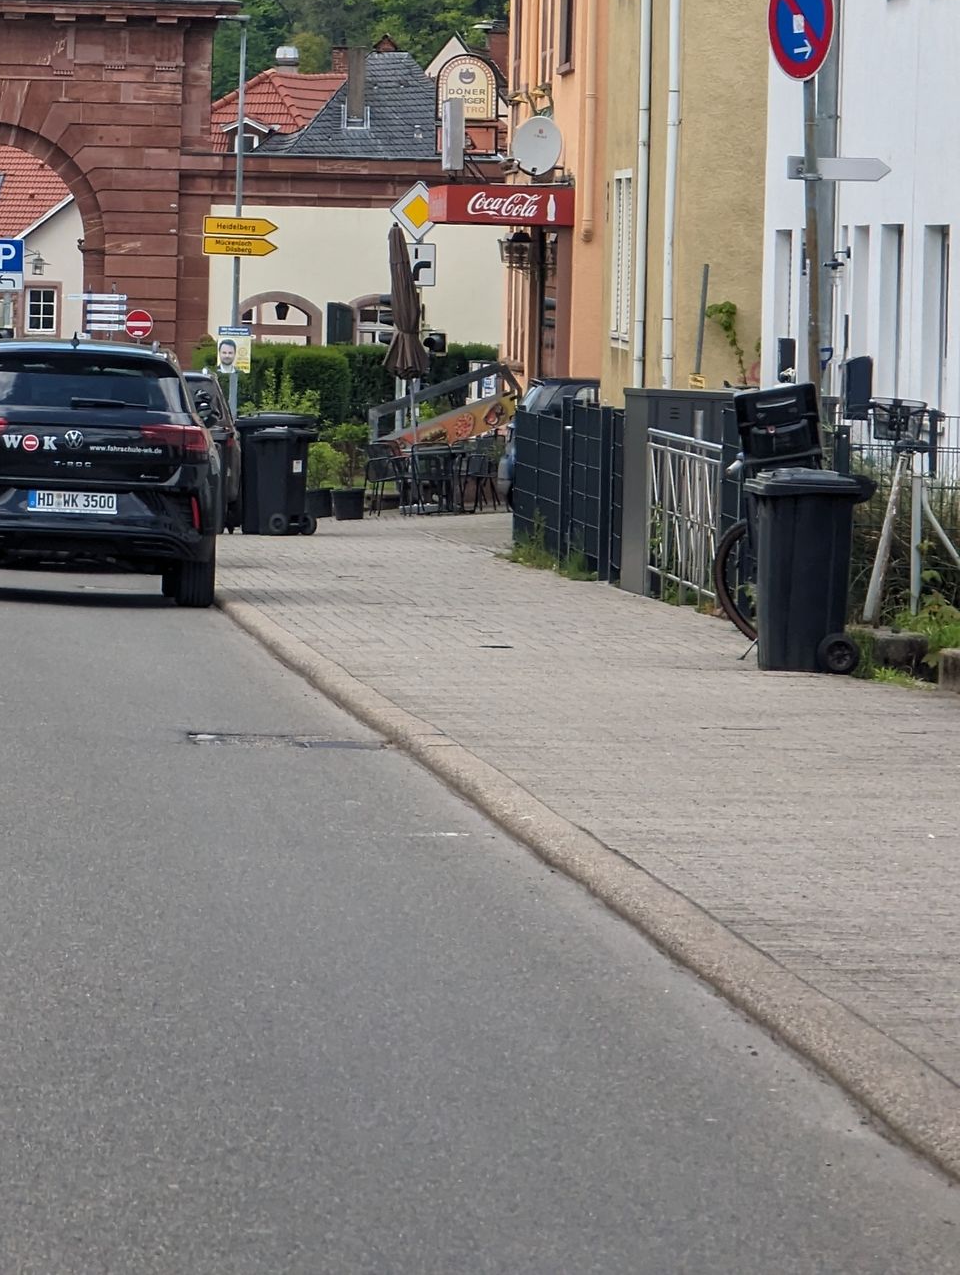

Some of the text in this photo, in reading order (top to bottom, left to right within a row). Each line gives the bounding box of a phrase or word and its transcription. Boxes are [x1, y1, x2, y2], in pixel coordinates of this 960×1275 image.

[466, 191, 543, 218] Coca-Cola
[216, 222, 256, 232] Heidelberg
[225, 246, 253, 254] Dilsberg
[89, 444, 163, 455] www.fahrschule-wk.de
[37, 492, 115, 509] HD WK 3500
